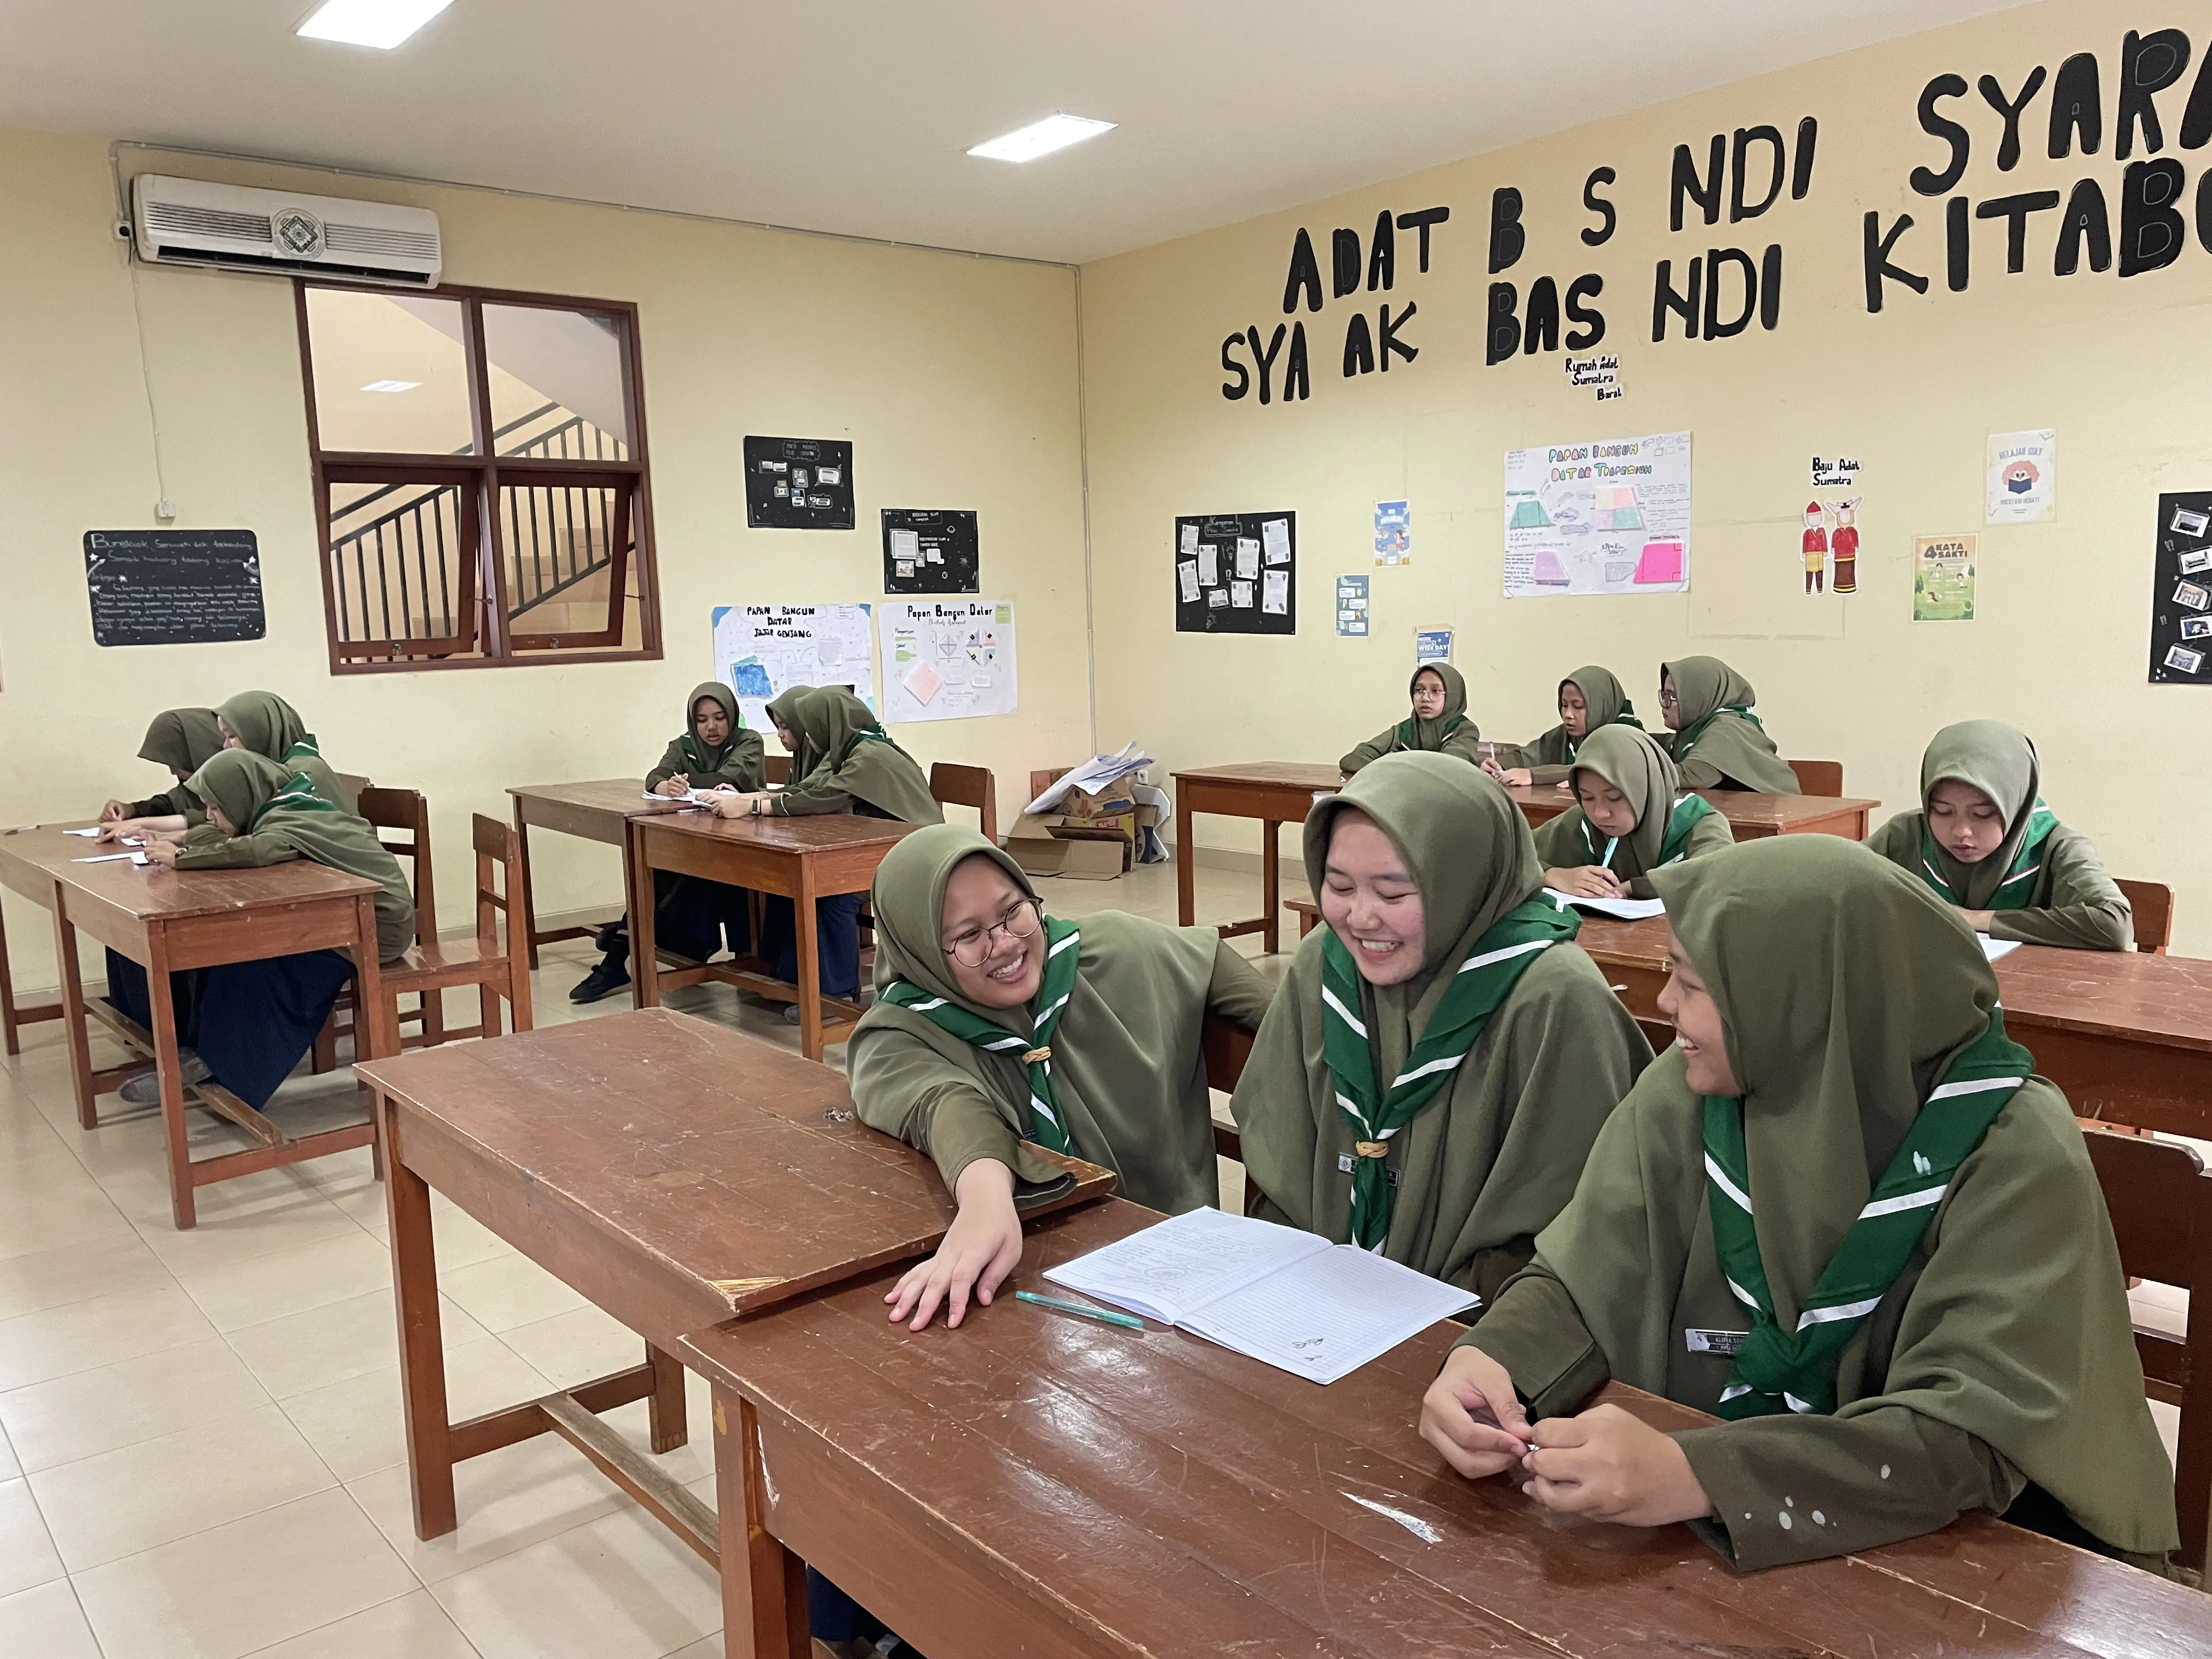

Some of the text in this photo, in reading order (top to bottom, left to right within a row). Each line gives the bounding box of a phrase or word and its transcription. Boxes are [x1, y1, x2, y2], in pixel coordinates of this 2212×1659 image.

[1283, 207, 1449, 313] ADAT
[1565, 356, 1618, 373] Rumah Adat
[1572, 371, 1613, 385] Sumatra
[1597, 387, 1622, 400] Barat
[1549, 443, 1638, 463] PAPAN BANGUN
[1551, 462, 1652, 482] DATAR TRAPESIUM
[1813, 457, 1860, 474] Baju Adat
[1813, 473, 1852, 486] Sumatra
[1924, 545, 1937, 560] 4
[1938, 550, 1967, 558] SAKTI
[747, 606, 815, 616] PAPAN BANGUN
[907, 605, 931, 621] Papan
[935, 604, 965, 621] Bangun
[969, 603, 992, 616] Datar
[767, 616, 792, 626] DATAR
[754, 628, 811, 638] JAJAR GENJANG
